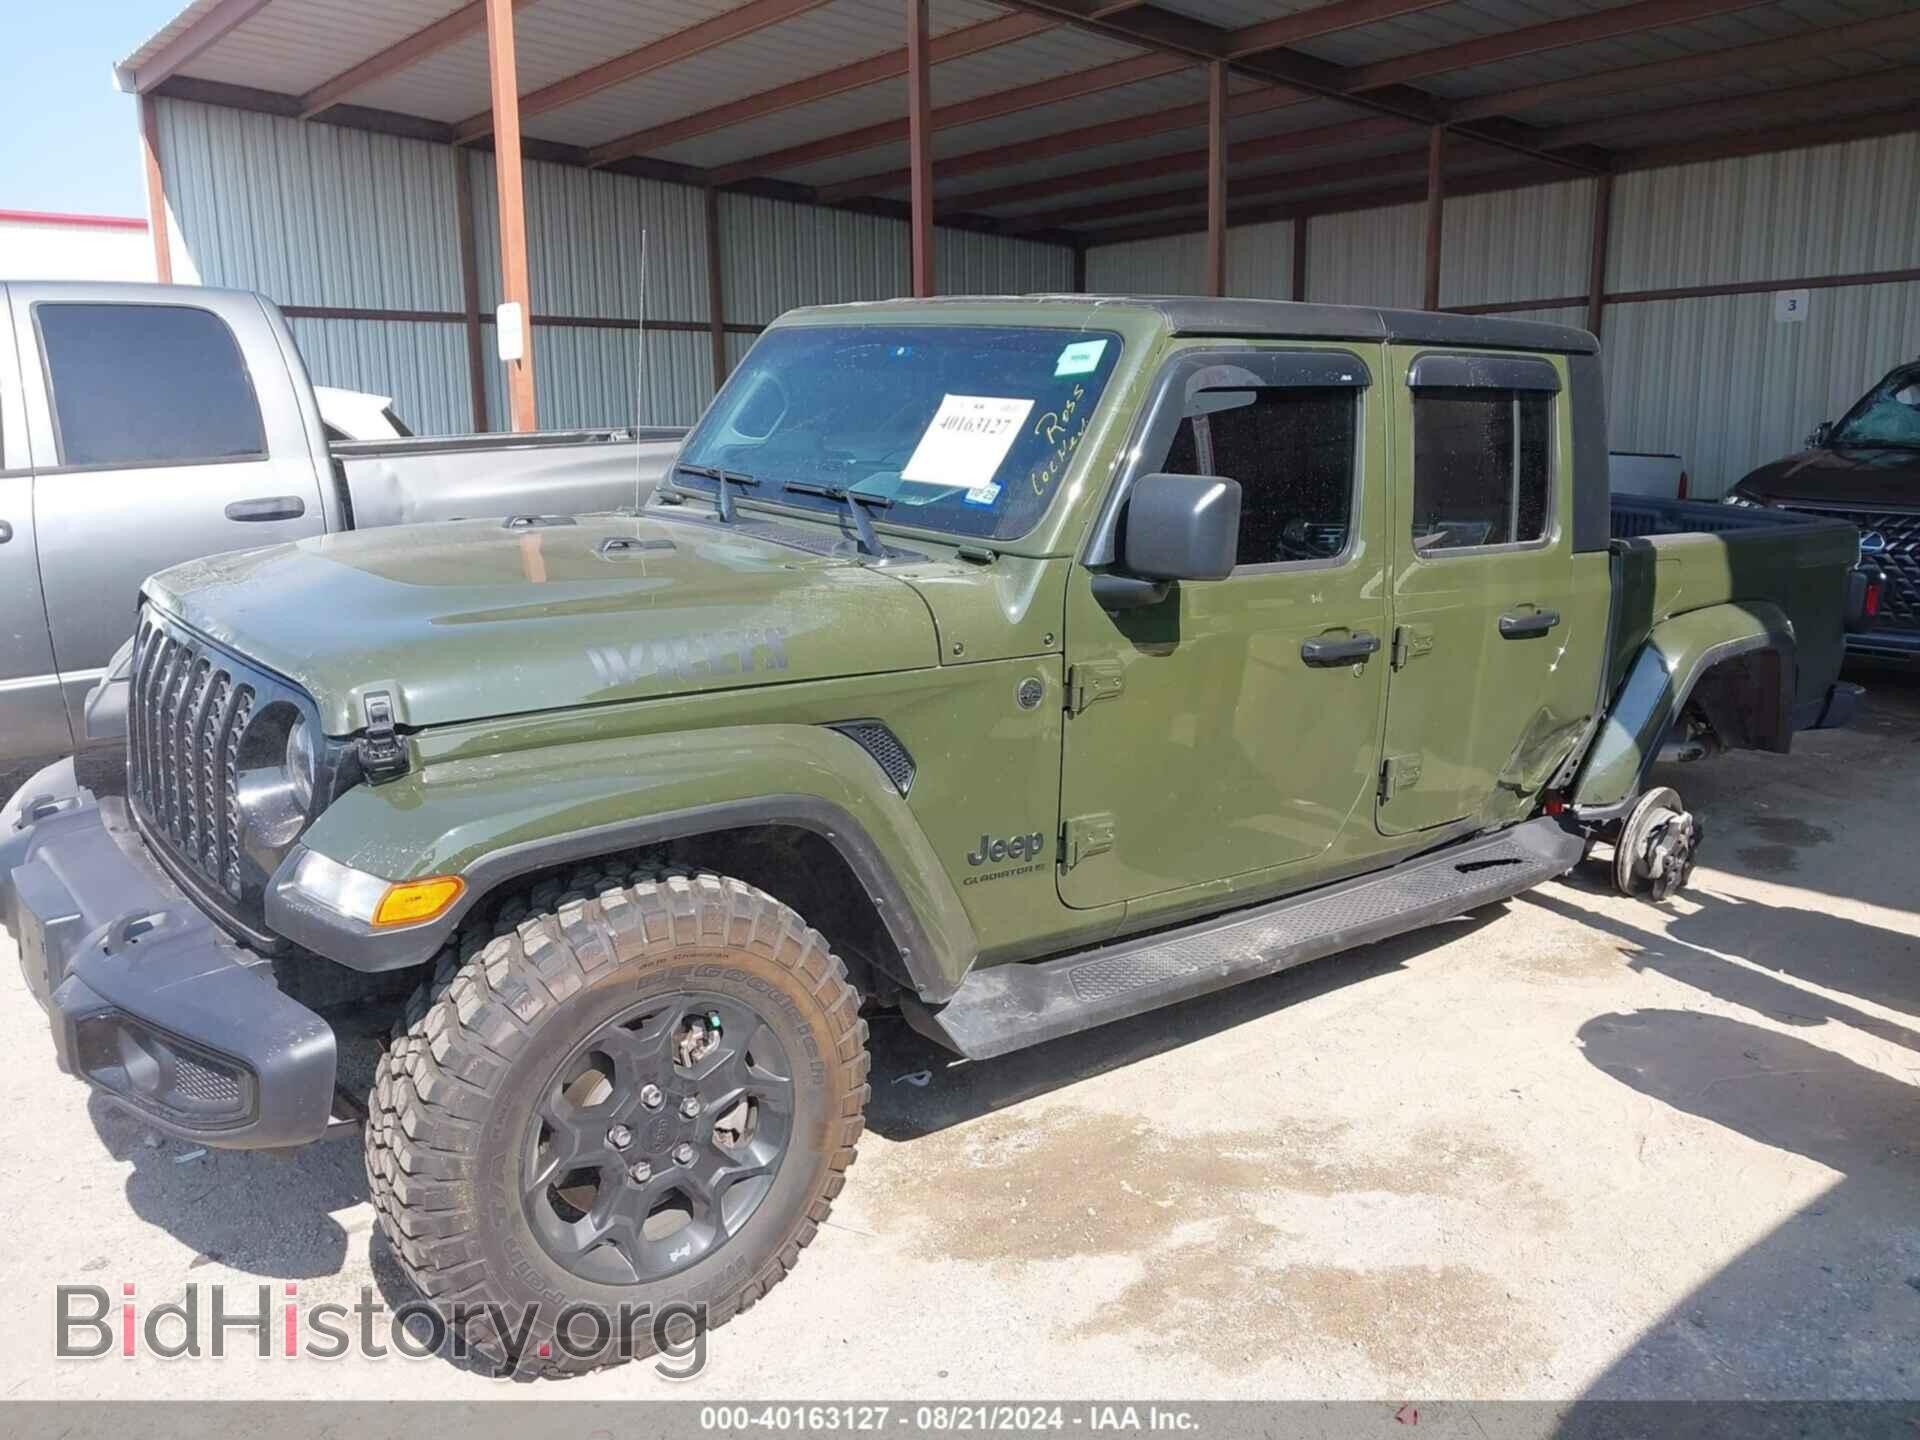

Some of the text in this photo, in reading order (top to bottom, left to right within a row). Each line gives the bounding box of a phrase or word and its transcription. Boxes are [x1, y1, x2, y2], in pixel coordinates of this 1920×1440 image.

[1788, 300, 1797, 311] 3
[939, 415, 1012, 433] 40163127
[967, 832, 1043, 865] Jeep
[963, 864, 1033, 885] GLADIATOR
